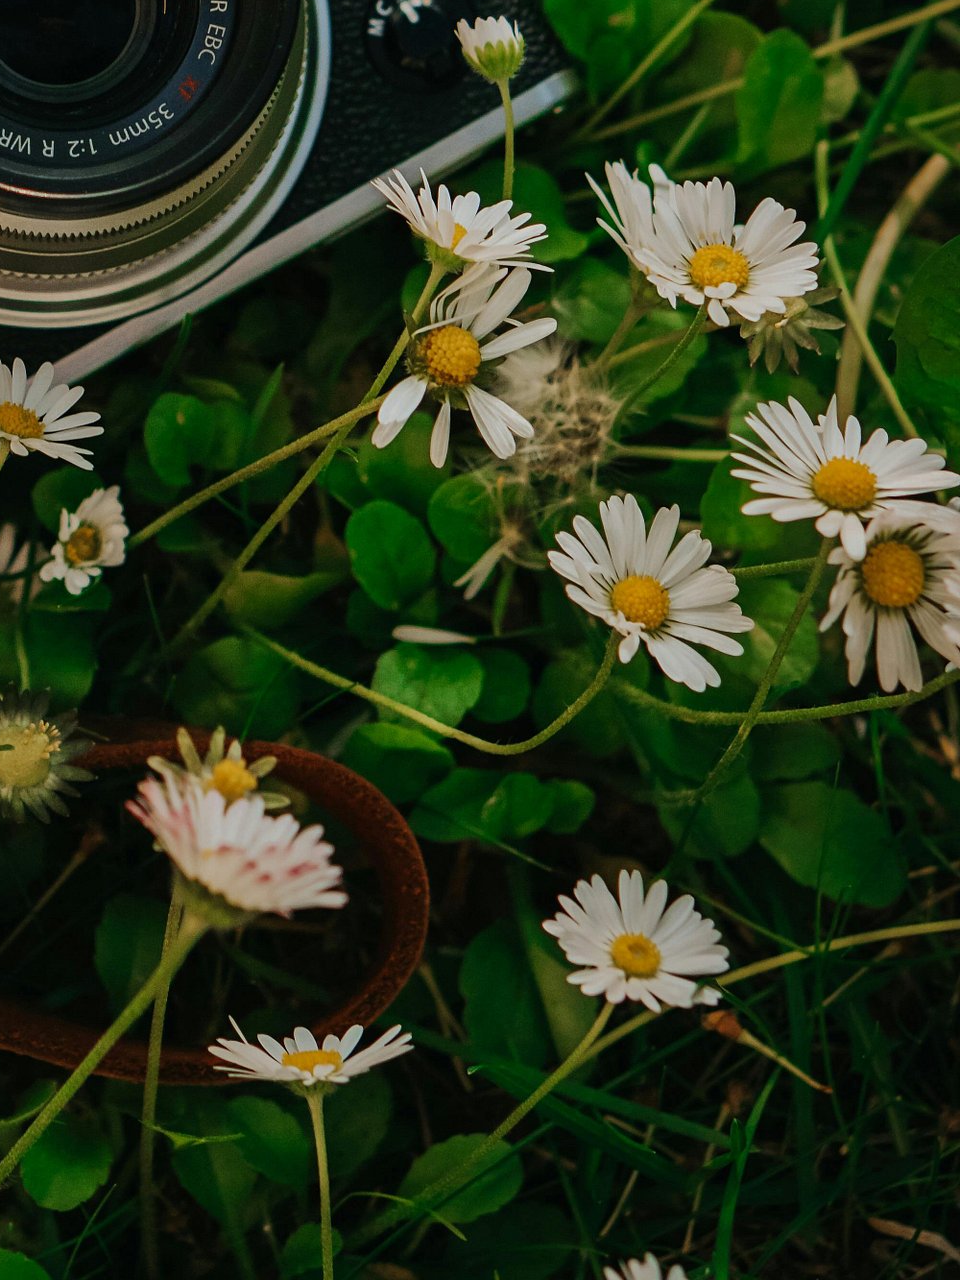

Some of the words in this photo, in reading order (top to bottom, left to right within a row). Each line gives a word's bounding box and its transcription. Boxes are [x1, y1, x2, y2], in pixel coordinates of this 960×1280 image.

[197, 23, 227, 66] EBC
[108, 102, 175, 147] 35mm
[42, 139, 56, 158] R
[67, 137, 98, 158] 1:2
